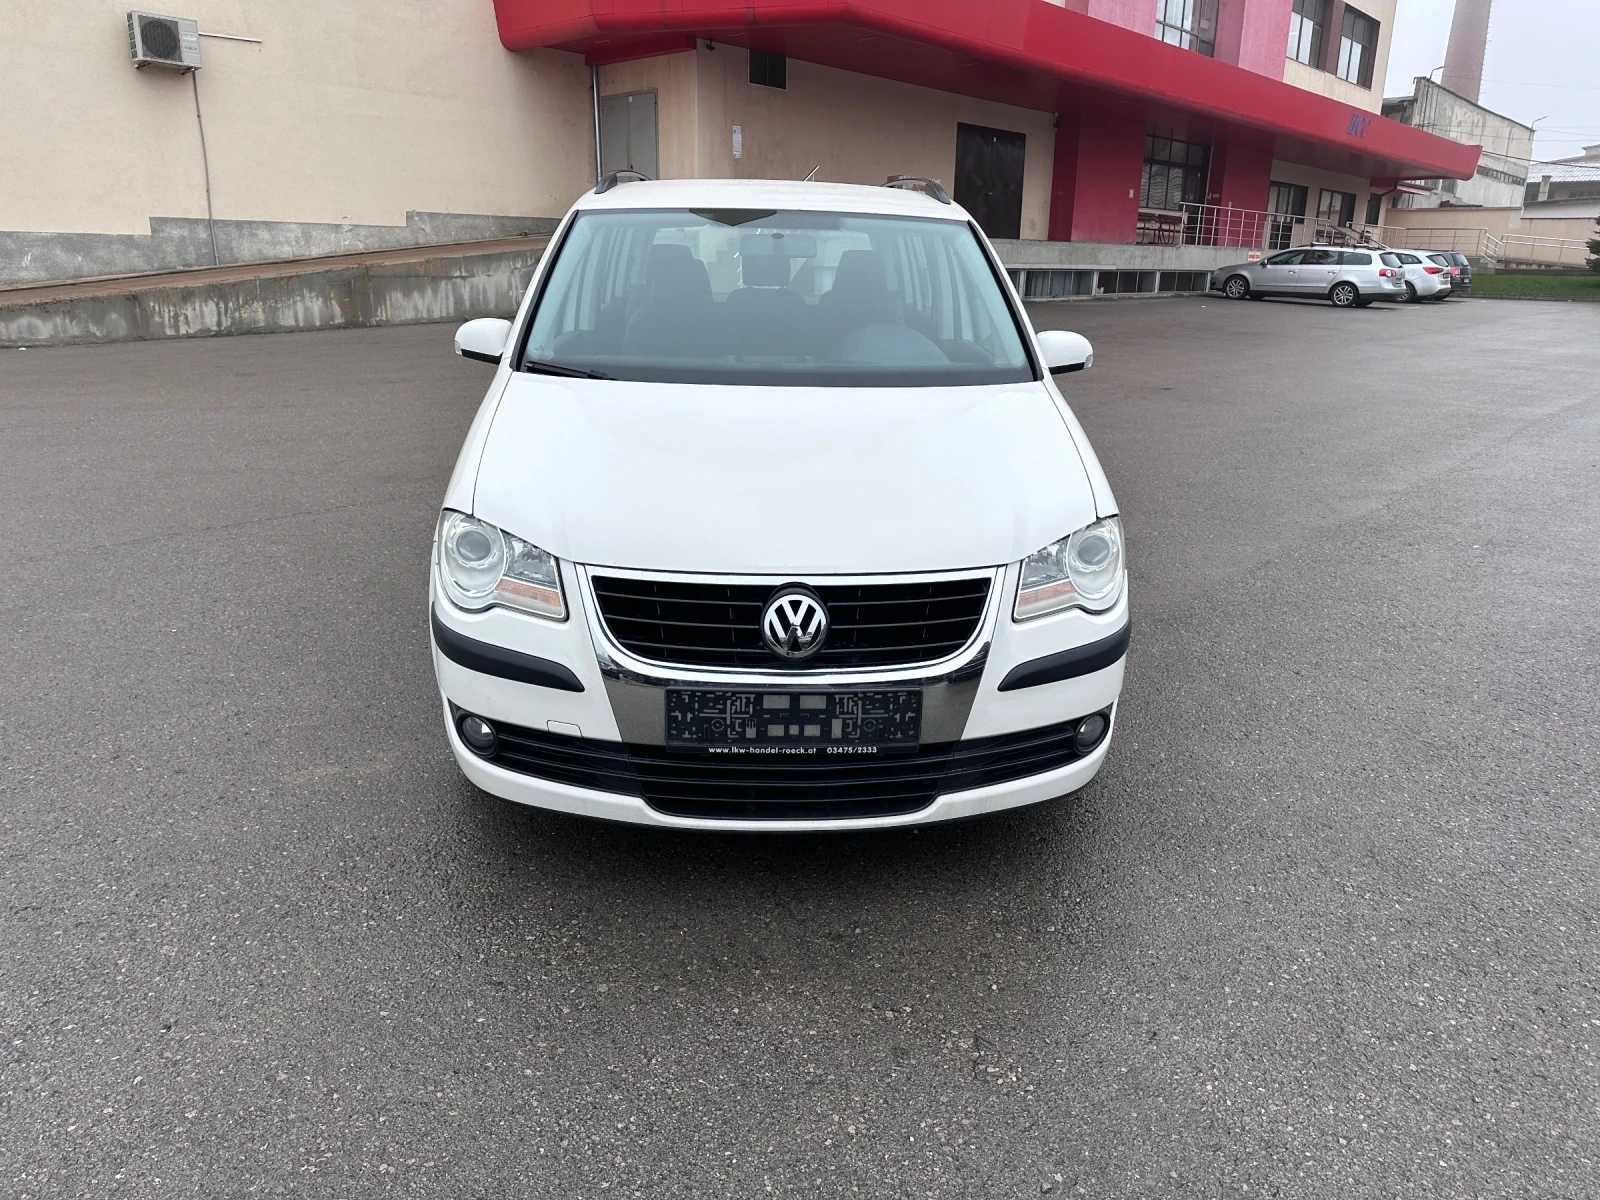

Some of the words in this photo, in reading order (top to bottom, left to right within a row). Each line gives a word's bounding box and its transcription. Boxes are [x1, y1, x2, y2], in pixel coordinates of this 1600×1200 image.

[764, 594, 827, 658] VW
[708, 746, 817, 755] www.lkw-handel-roeck.at
[826, 746, 878, 755] 03475/2333
